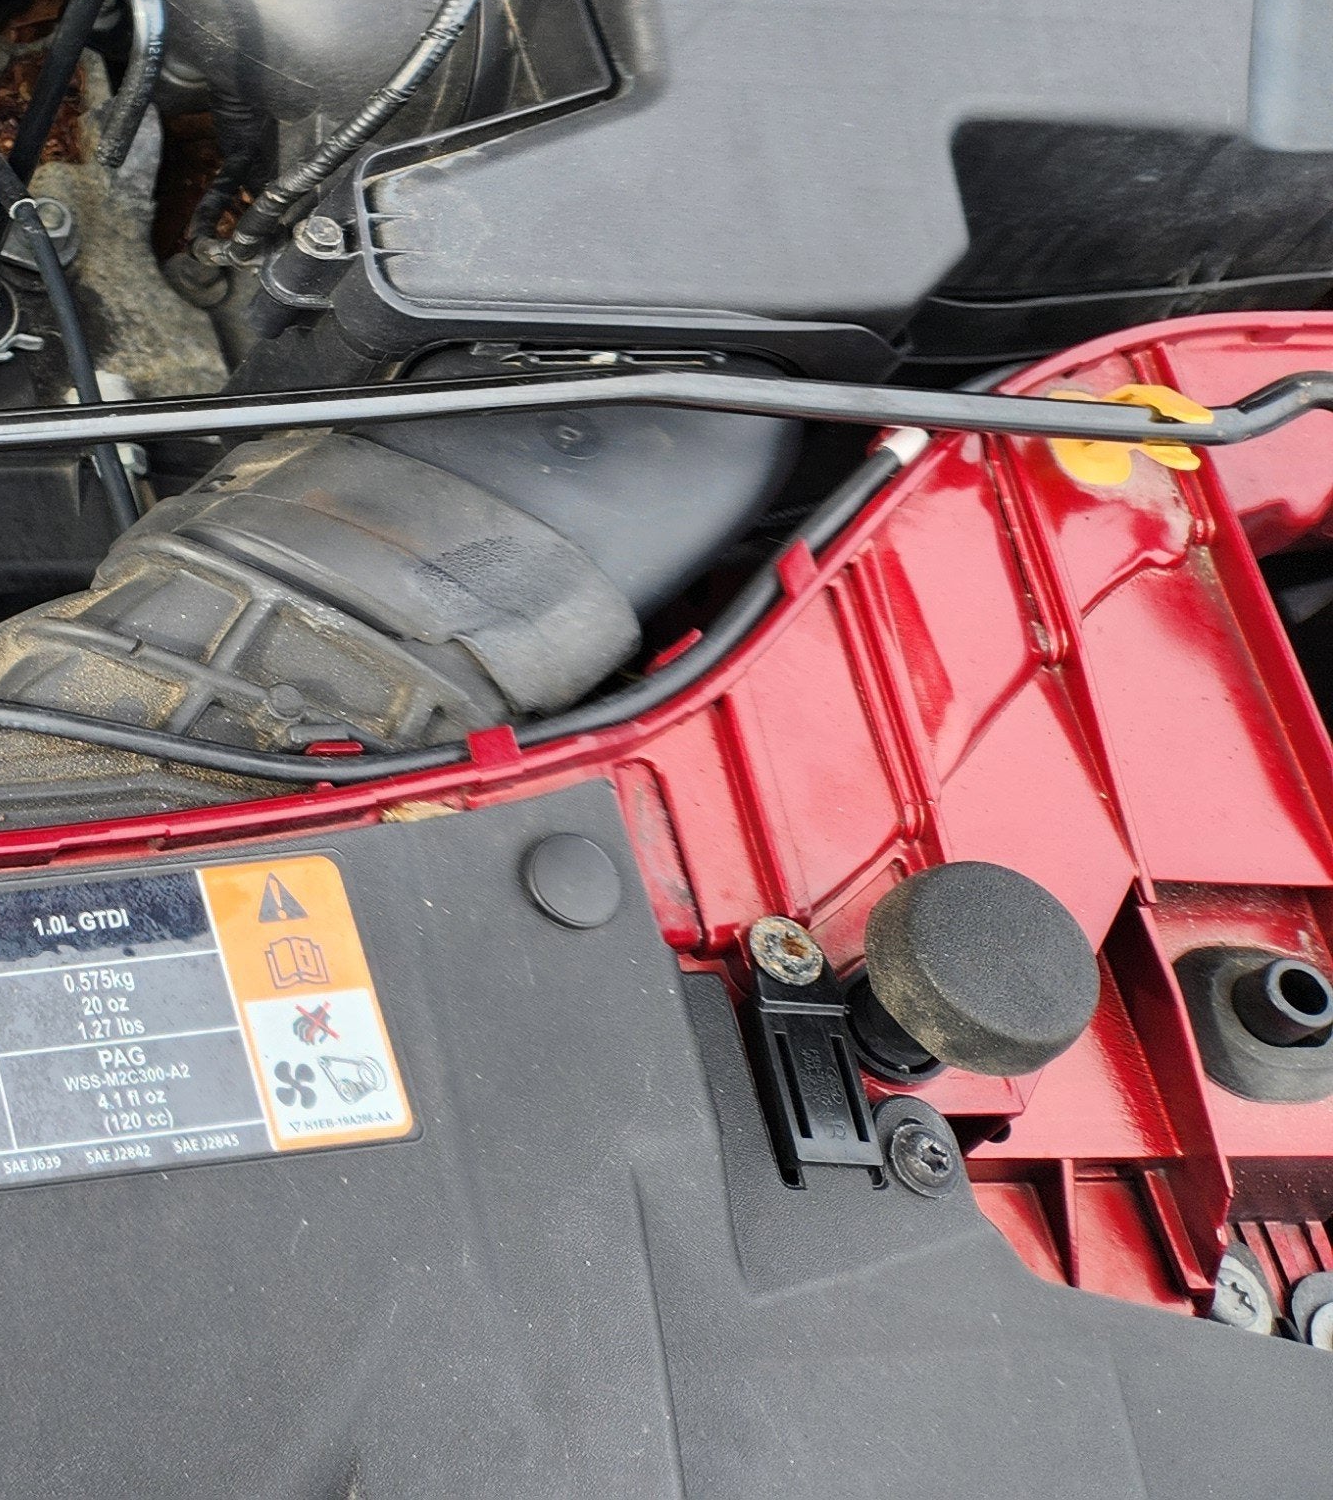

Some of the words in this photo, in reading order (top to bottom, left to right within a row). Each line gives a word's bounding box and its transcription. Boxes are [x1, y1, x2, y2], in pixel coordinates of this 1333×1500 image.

[33, 915, 77, 937] 1.0L
[77, 908, 130, 931] GTDI
[63, 968, 135, 993] 0.575kg
[81, 996, 103, 1016] 20
[107, 997, 130, 1013] oz
[77, 1019, 112, 1041] 1.27
[116, 1016, 146, 1036] lbs
[97, 1046, 147, 1070] PAG
[63, 1062, 191, 1092] WSS-M2C300-A2
[97, 1091, 124, 1110] 4.1
[127, 1089, 141, 1107] fl
[144, 1090, 167, 1105] oz
[104, 1110, 143, 1136] (120
[145, 1107, 174, 1130] cc)
[85, 1149, 111, 1165] SAE
[113, 1144, 153, 1162] J2842
[173, 1138, 199, 1155] SAE
[3, 1159, 30, 1175] SAE
[32, 1155, 62, 1172] J639
